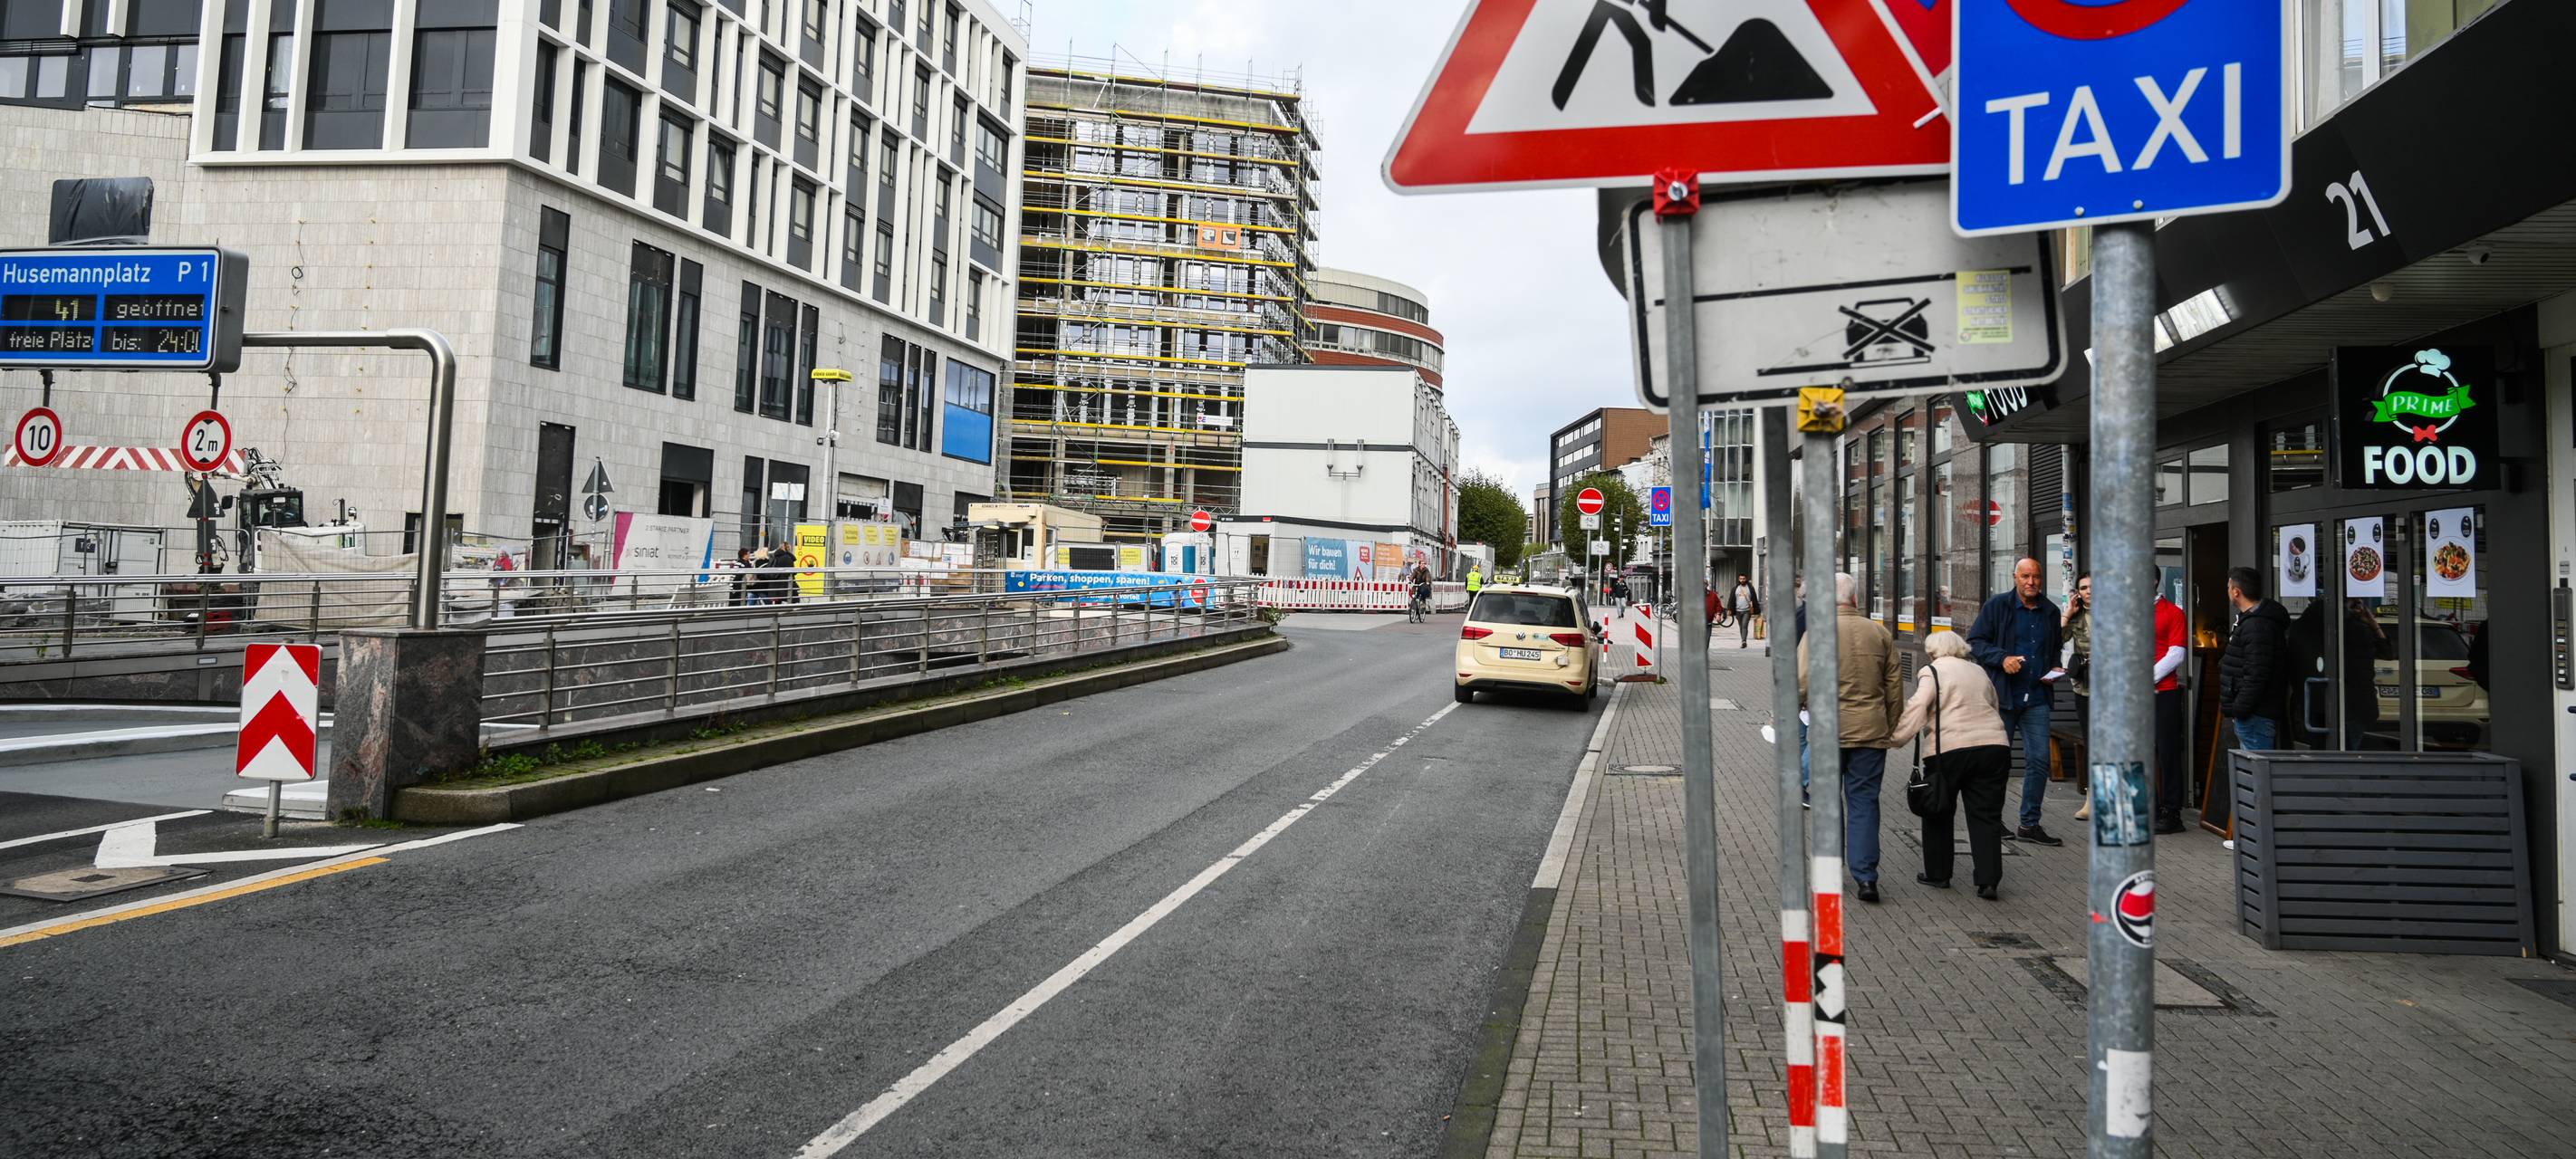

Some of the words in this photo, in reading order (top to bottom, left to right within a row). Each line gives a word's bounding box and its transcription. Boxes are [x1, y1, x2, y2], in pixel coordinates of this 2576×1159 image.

[1985, 62, 2242, 186] TAXI
[2325, 169, 2391, 250] 21
[3, 262, 152, 288] Husemannplatz
[178, 261, 192, 283] P
[201, 261, 209, 283] 1
[55, 299, 80, 321] 41
[9, 331, 44, 349] freie
[49, 331, 94, 349] Plätz
[112, 331, 141, 351] bis:
[2392, 395, 2454, 415] PRIME
[29, 425, 52, 451] 10
[195, 428, 205, 452] 2
[207, 439, 218, 452] m
[2363, 445, 2476, 484] FOOD
[1652, 513, 1669, 522] TAXI
[634, 546, 659, 559] siniat
[1308, 544, 1321, 555] Wir
[1322, 545, 1342, 558] bauen
[1308, 558, 1319, 570] für
[1029, 573, 1067, 585] Parken,
[1070, 575, 1113, 587] shoppen,
[1116, 575, 1149, 586] sparen!
[1526, 650, 1540, 659] 245
